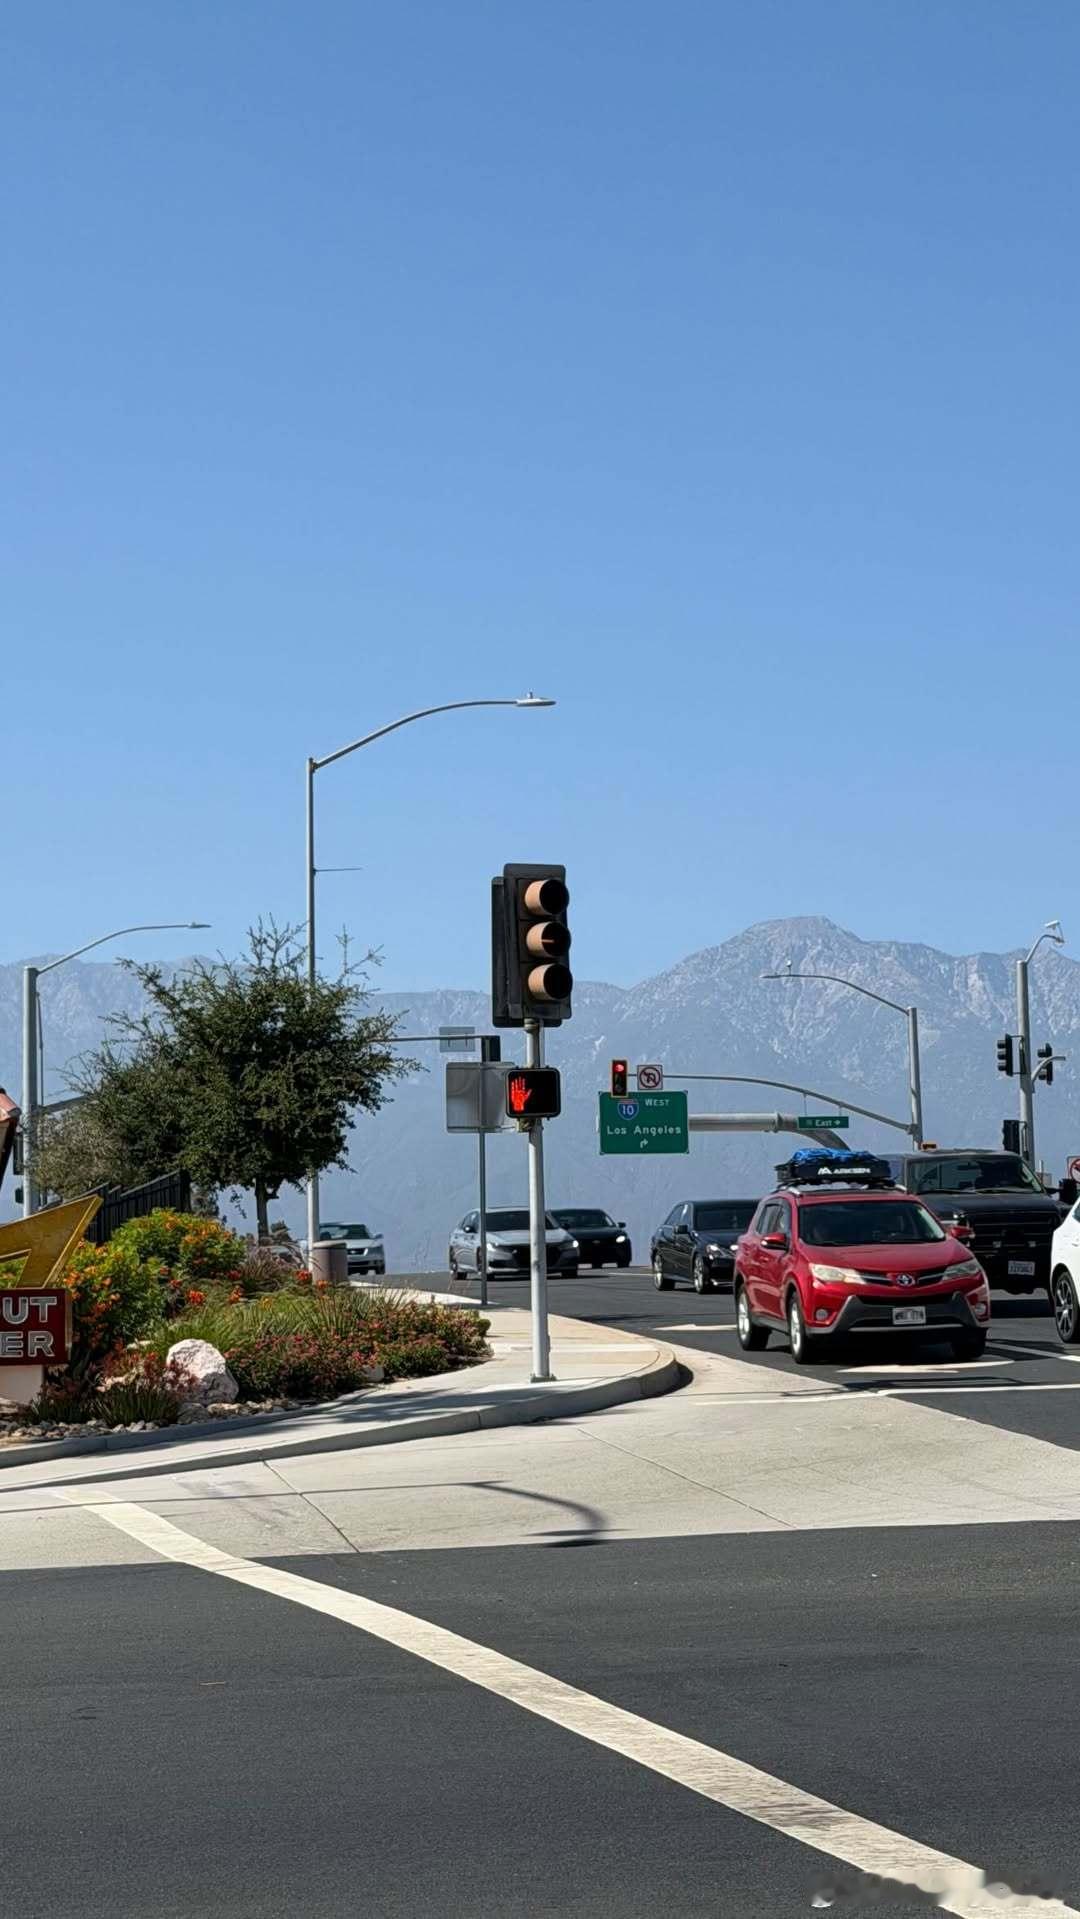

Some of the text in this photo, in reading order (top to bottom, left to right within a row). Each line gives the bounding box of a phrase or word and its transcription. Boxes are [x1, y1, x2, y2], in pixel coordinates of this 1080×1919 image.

[622, 1104, 634, 1116] 10
[645, 1098, 670, 1107] WEST
[606, 1125, 682, 1137] Los Angeles
[0, 1330, 55, 1358] ER
